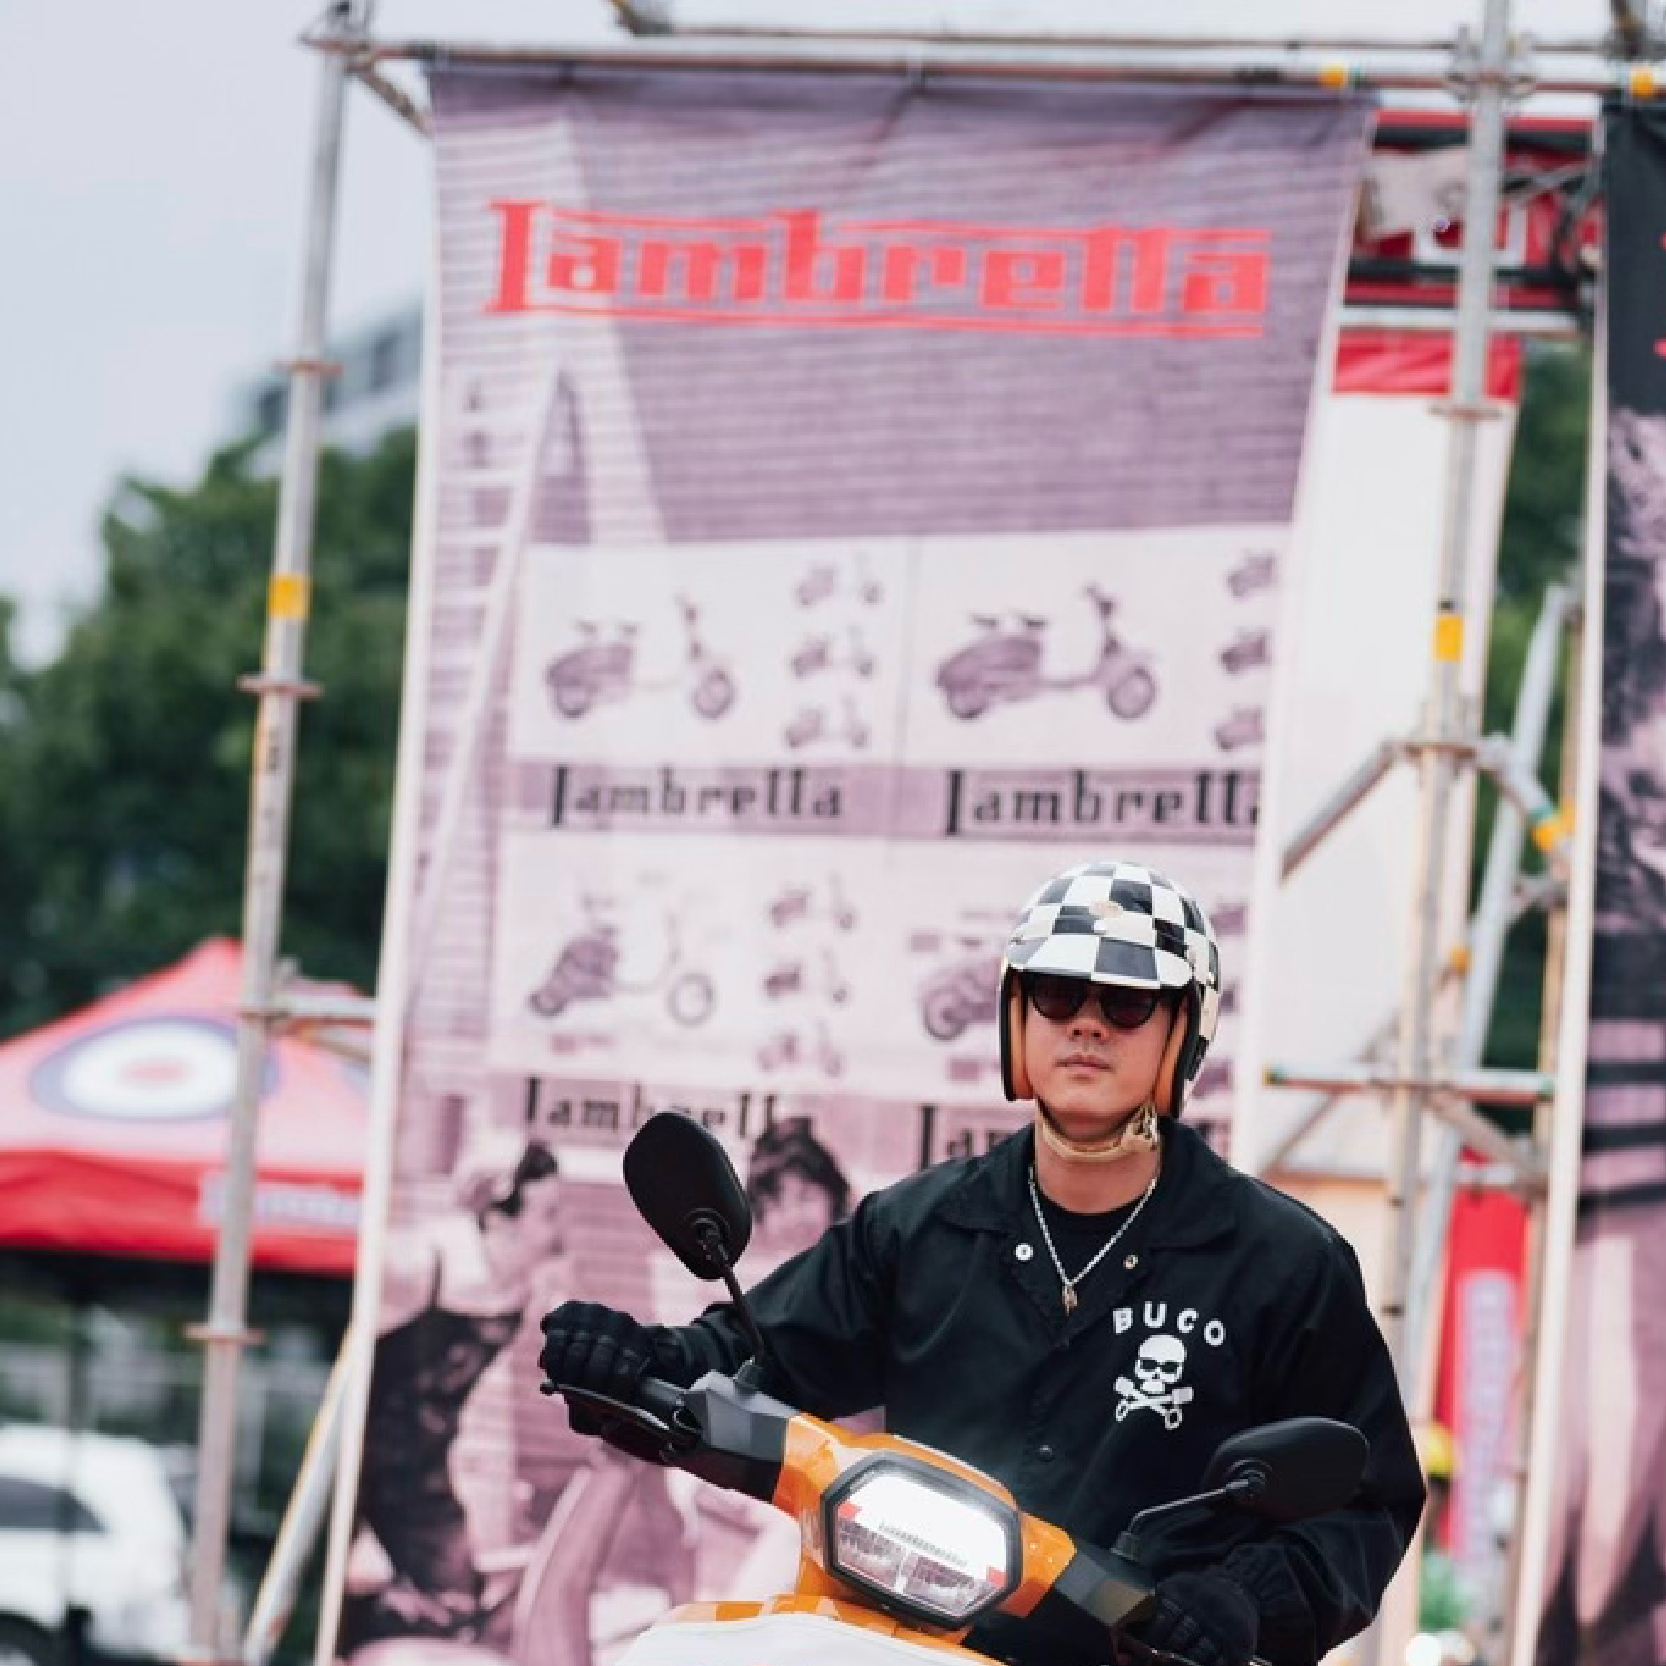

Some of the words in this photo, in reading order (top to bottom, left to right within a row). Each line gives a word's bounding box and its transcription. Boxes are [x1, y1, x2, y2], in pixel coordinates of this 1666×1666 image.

[482, 199, 1271, 337] Lambretta
[550, 765, 843, 828] Lambretta
[1113, 1301, 1225, 1346] BUCO
